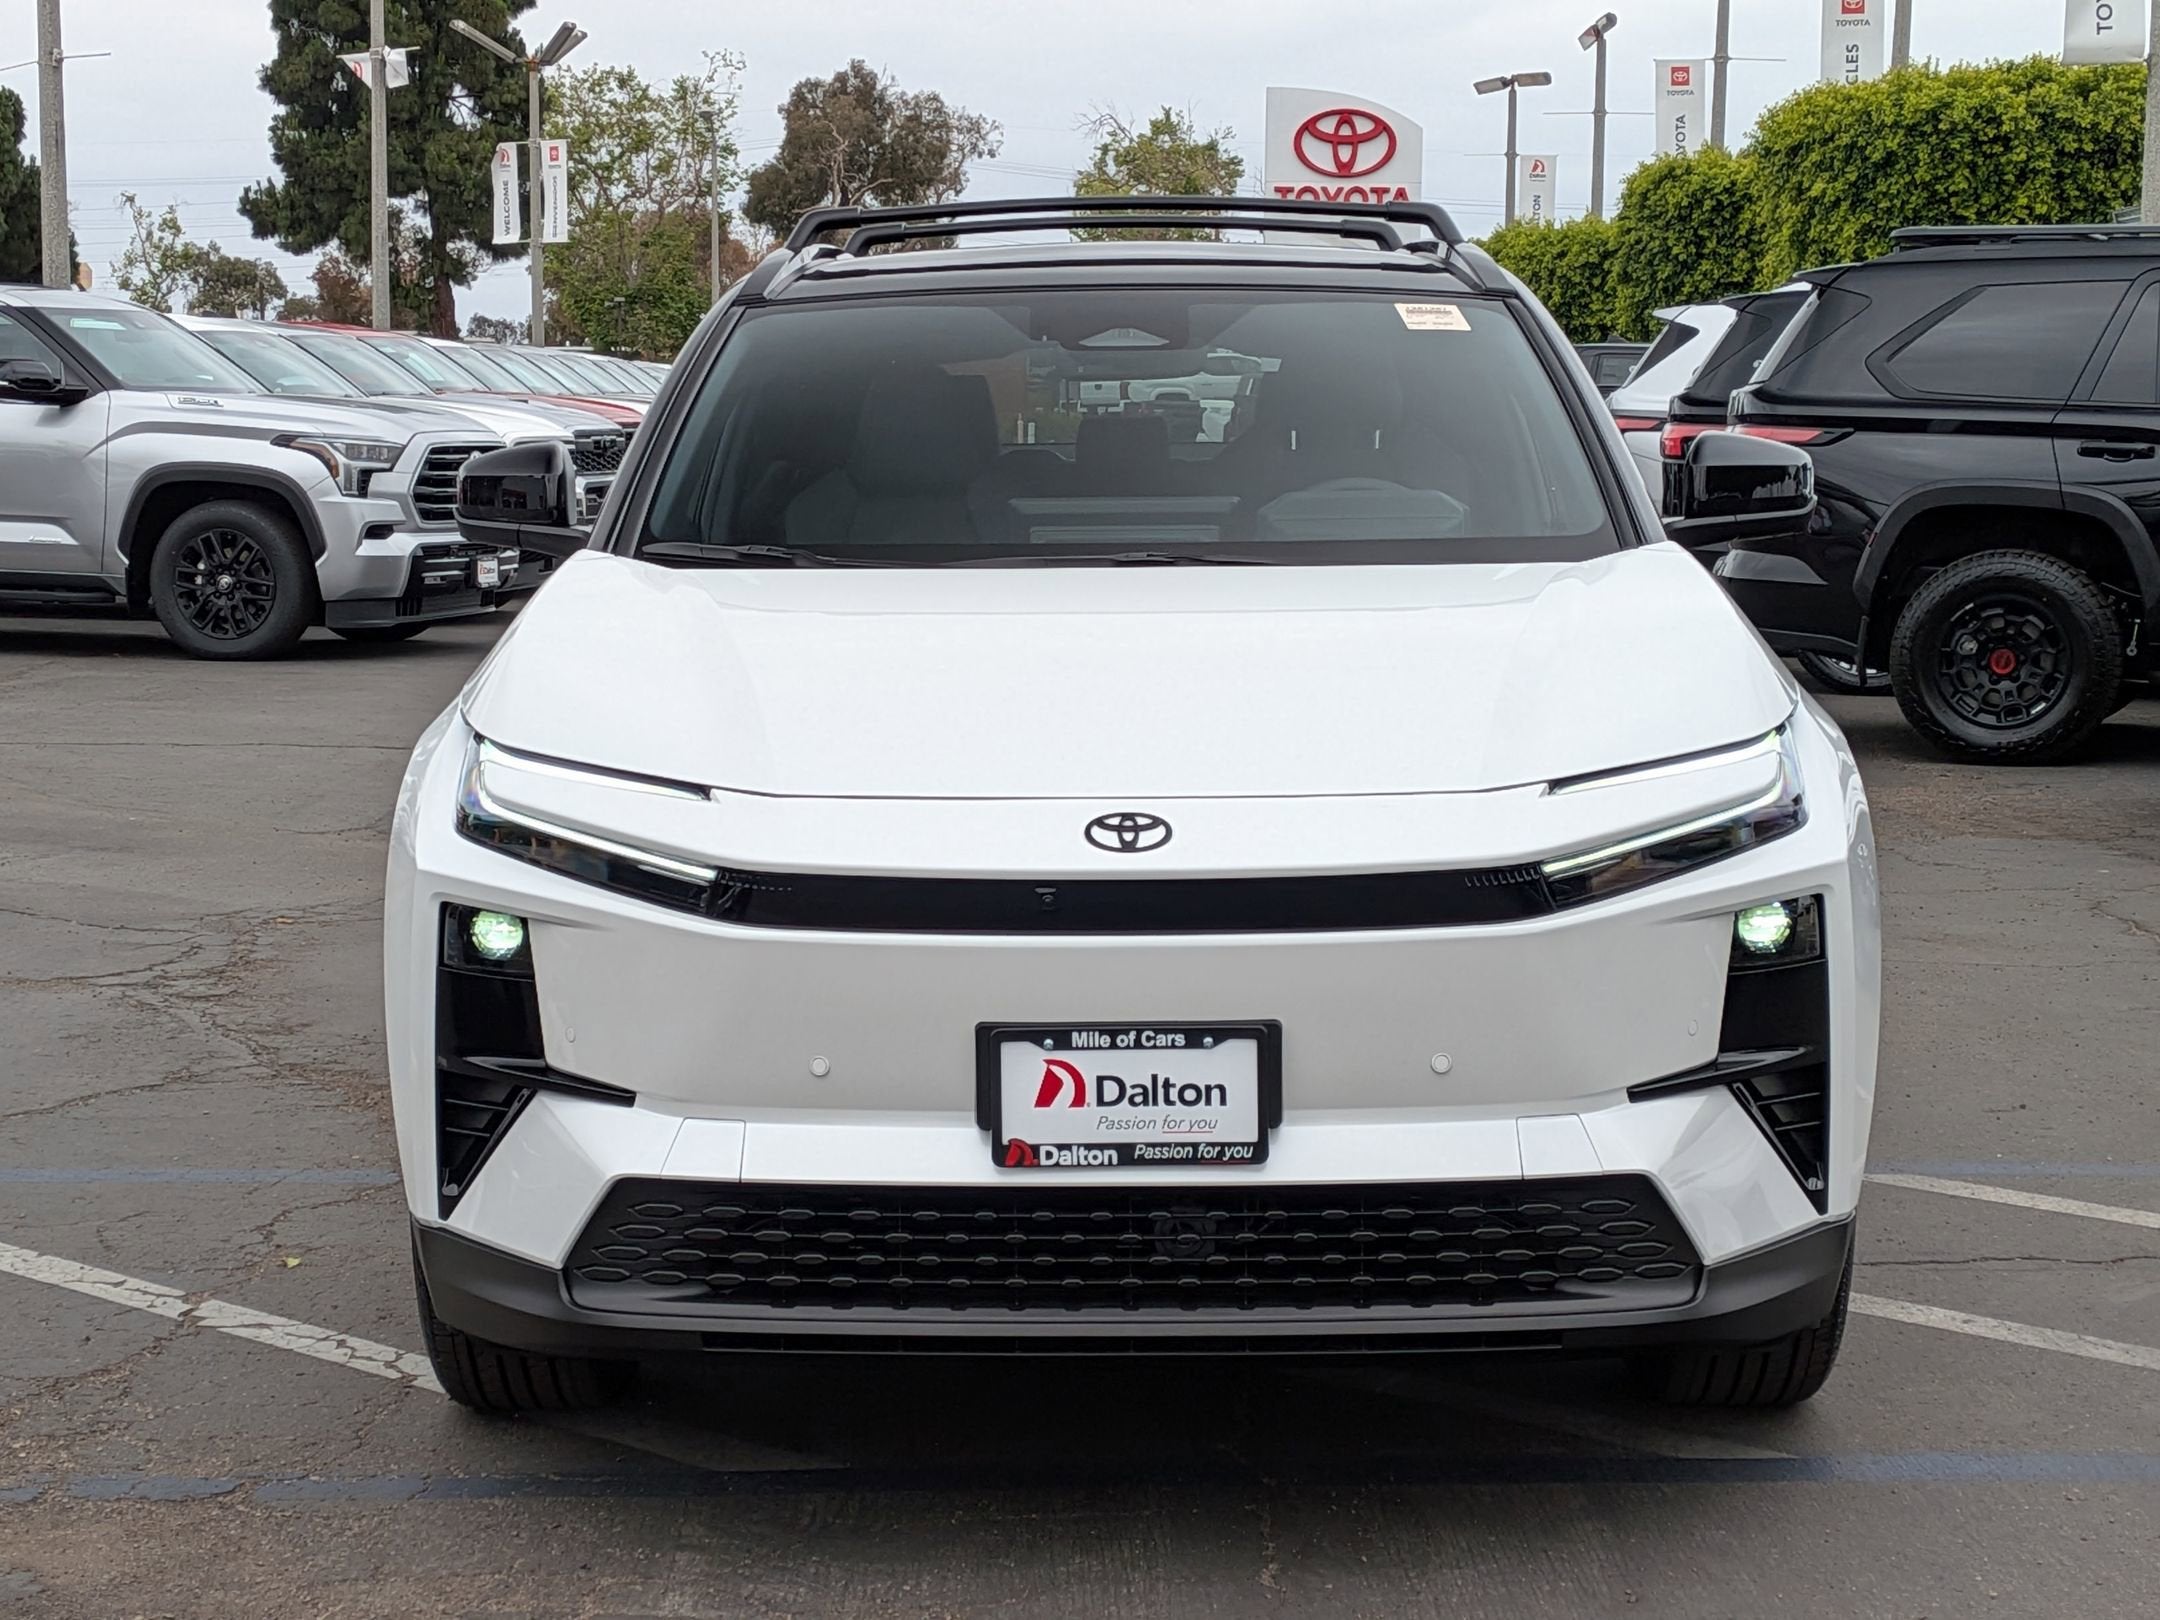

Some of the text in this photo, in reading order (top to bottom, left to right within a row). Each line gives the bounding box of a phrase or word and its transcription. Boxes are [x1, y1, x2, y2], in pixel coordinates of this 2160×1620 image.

[1835, 19, 1871, 27] TOYOTA
[2096, 0, 2113, 35] TO
[1666, 89, 1695, 97] TOYOTA
[1274, 186, 1409, 205] TOYOTA
[502, 180, 511, 237] WELCOME
[1071, 1030, 1186, 1048] Mile of Cars
[1096, 1073, 1228, 1107] Dalton
[1096, 1115, 1218, 1132] Passion for you
[1040, 1145, 1118, 1167] Dalton
[1134, 1143, 1254, 1161] Passion for you
